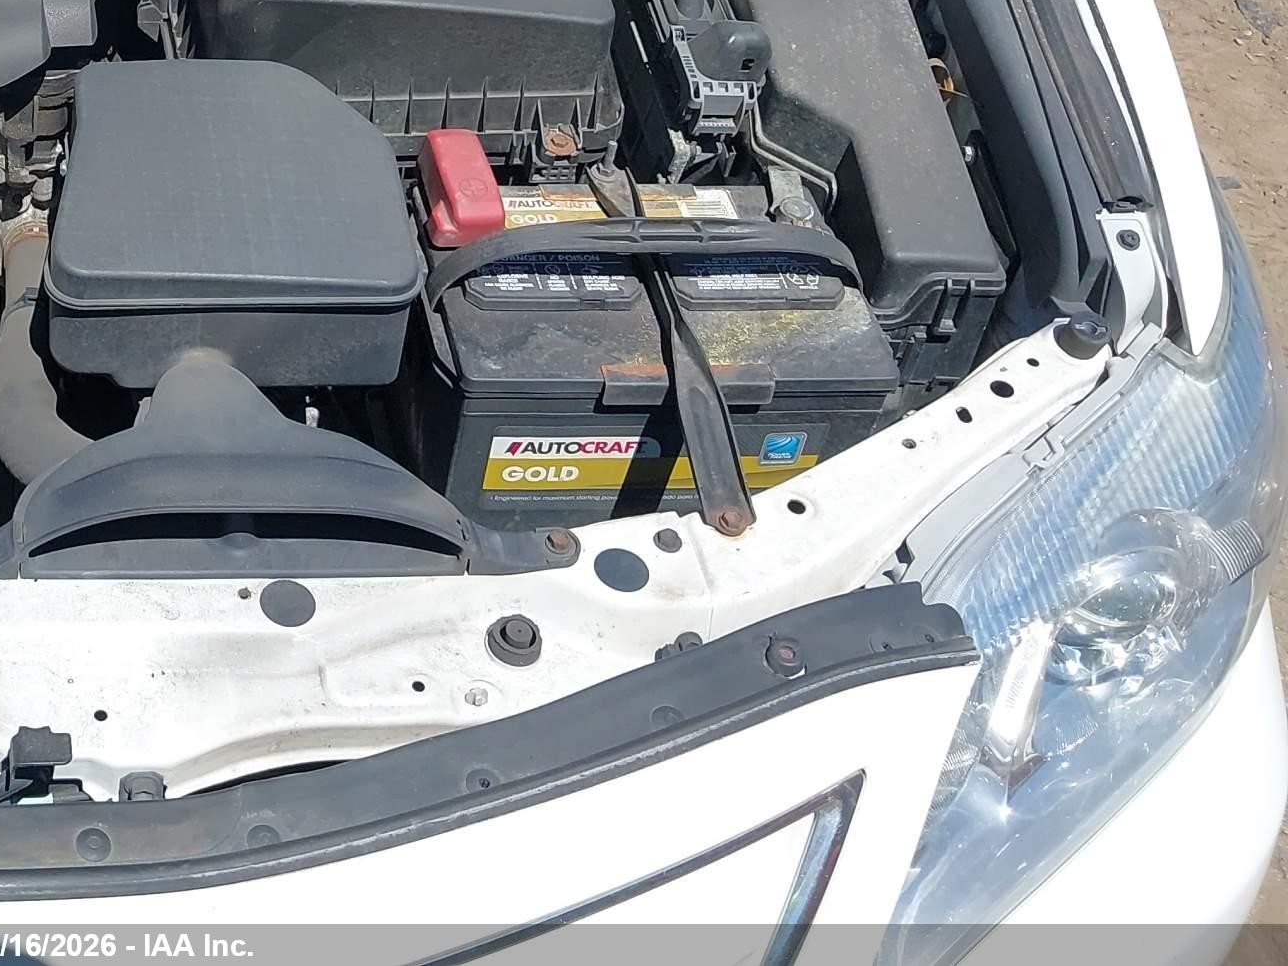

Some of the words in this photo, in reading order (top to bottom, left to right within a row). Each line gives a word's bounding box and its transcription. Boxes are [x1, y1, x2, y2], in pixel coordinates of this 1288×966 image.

[510, 214, 558, 224] GOLD
[557, 254, 601, 262] POISON
[519, 440, 647, 455] AUTOCRAFT
[502, 464, 579, 483] GOLD
